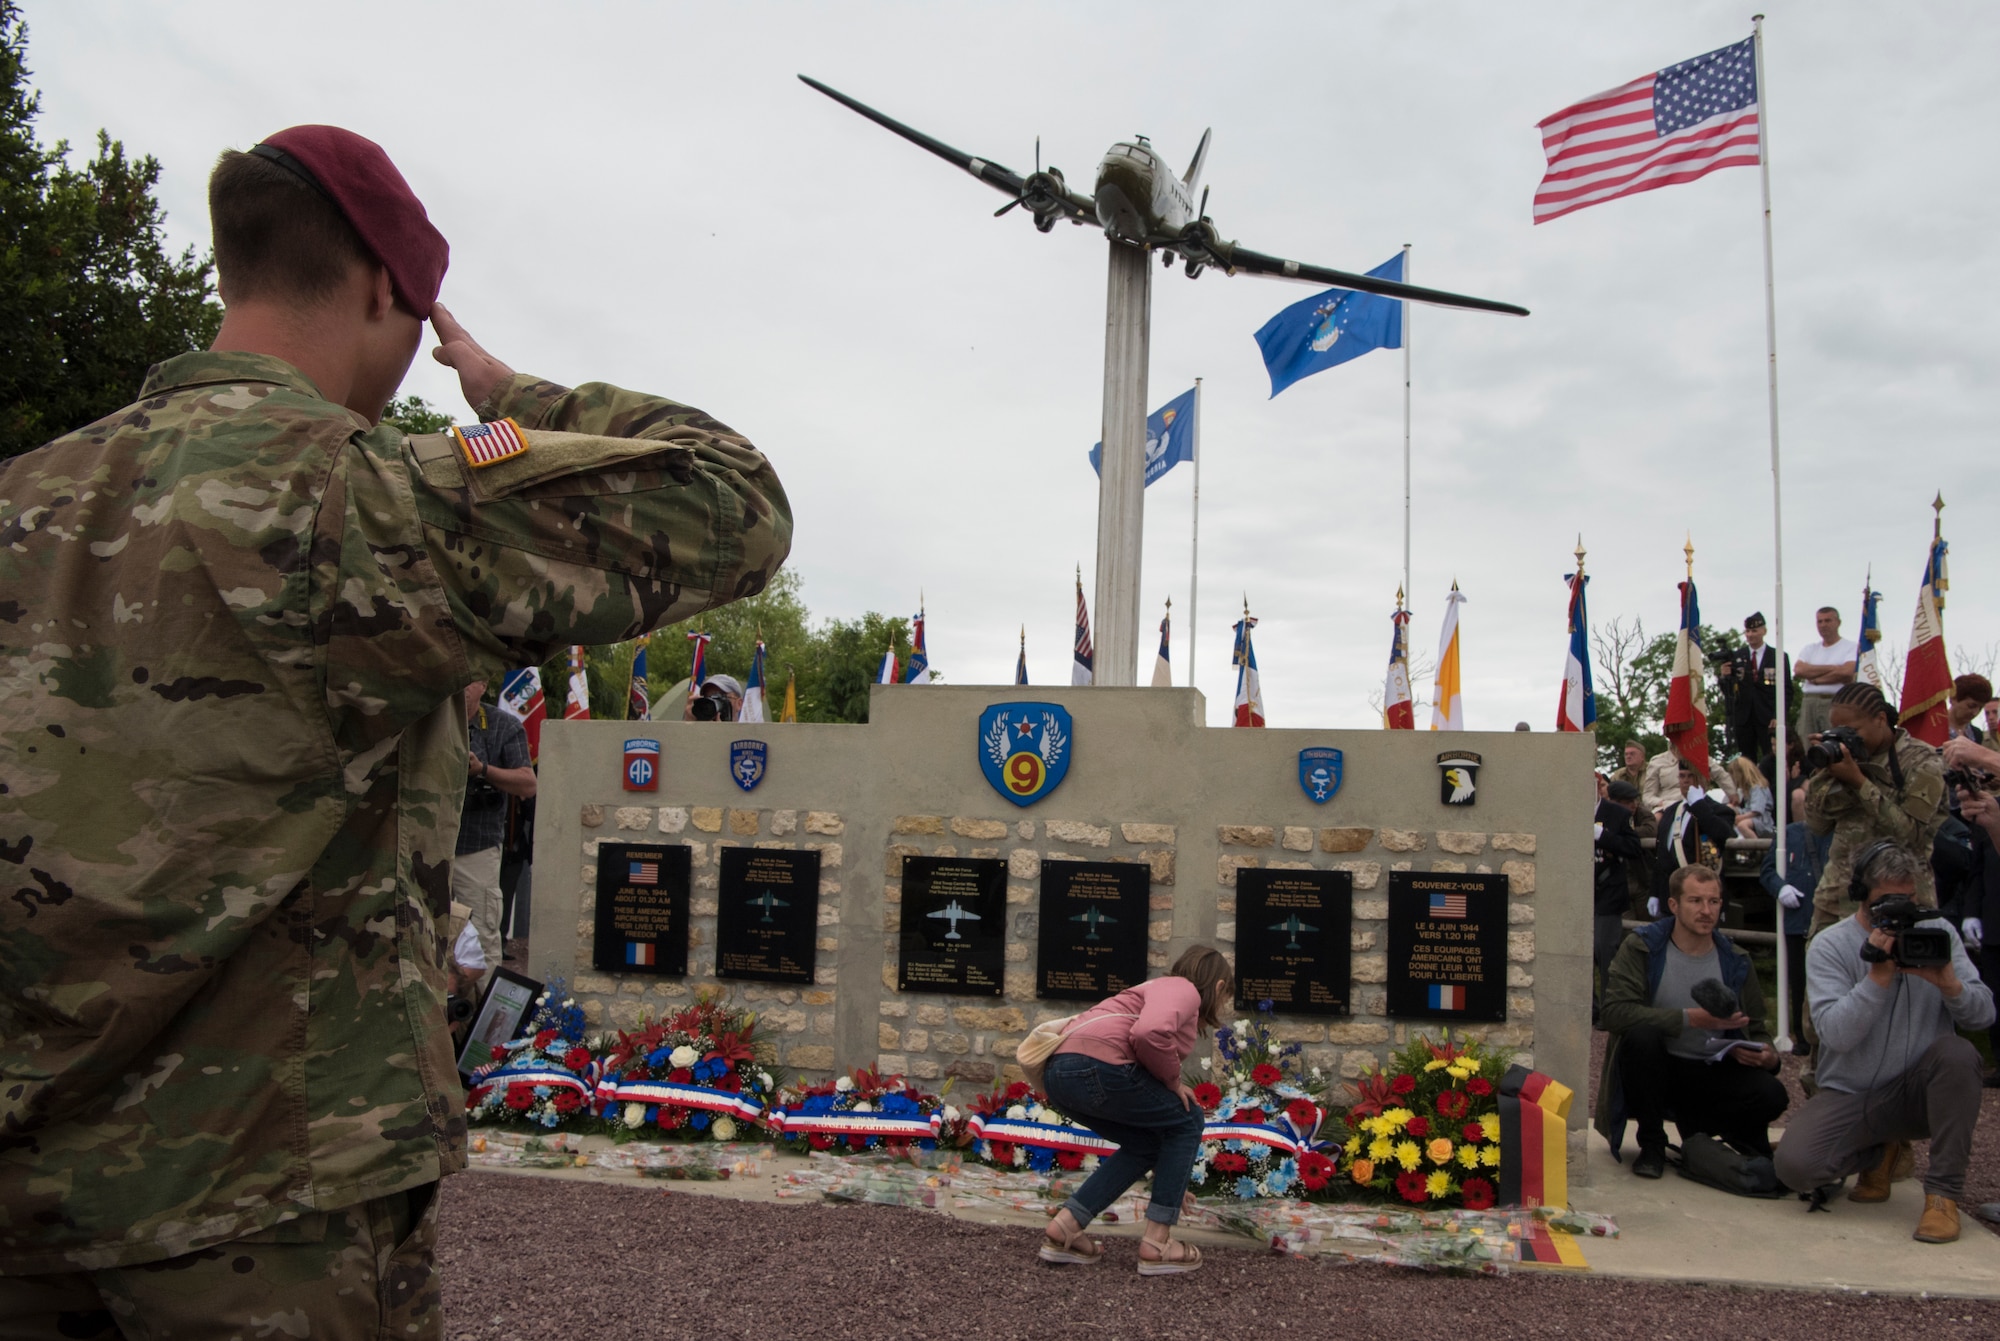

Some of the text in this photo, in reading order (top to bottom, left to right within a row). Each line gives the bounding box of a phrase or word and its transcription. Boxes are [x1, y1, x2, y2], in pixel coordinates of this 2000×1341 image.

[626, 741, 658, 749] AIRBORNE
[733, 742, 764, 751] AIRBORNE
[1440, 752, 1479, 762] AIRBORNE
[630, 758, 652, 783] AA
[1011, 754, 1039, 793] 9
[1412, 881, 1484, 891] SOUVENEZ-VOUS
[637, 908, 671, 916] AMERICAN
[1434, 946, 1481, 954] EQUIPAGES
[1411, 954, 1462, 962] AMERICAINS
[1409, 962, 1438, 970] DONNE
[1450, 973, 1484, 981] LIBERTE
[1003, 1123, 1043, 1140] COMMUNE
[1045, 1129, 1056, 1142] DE
